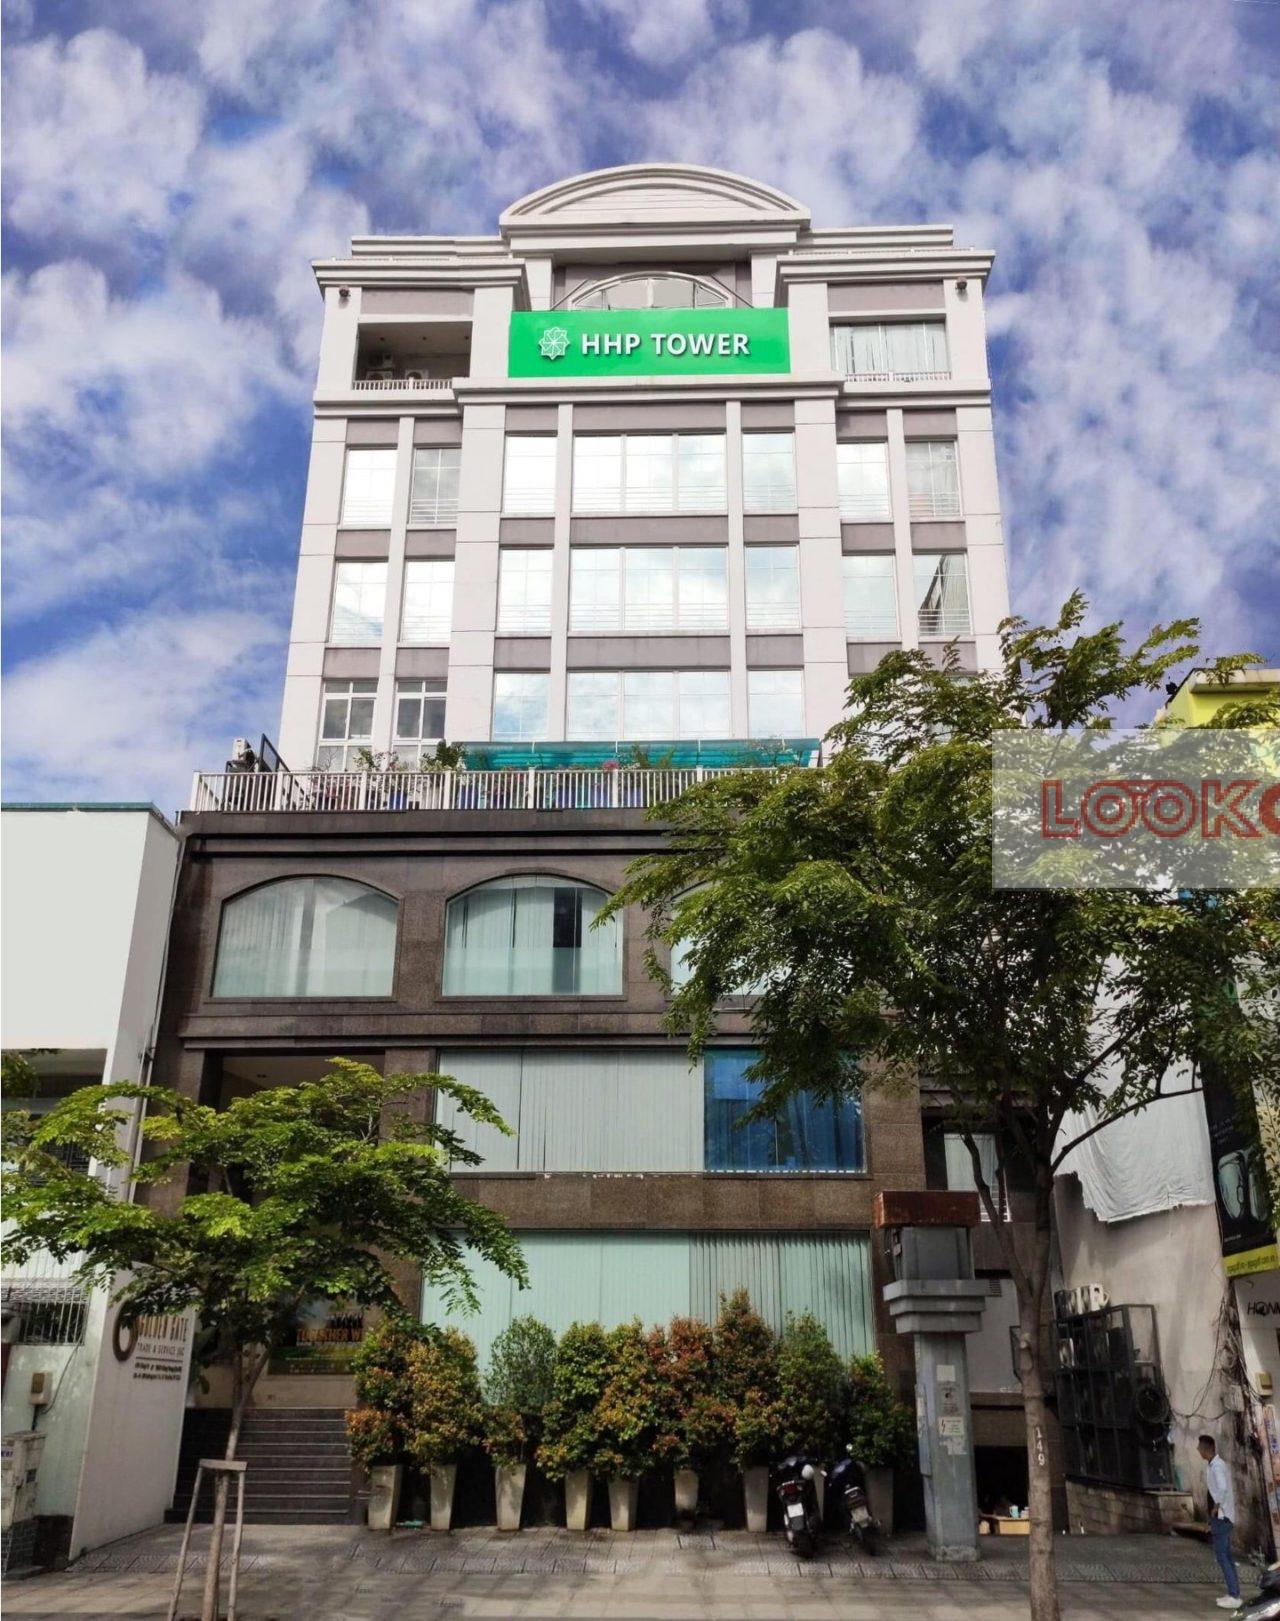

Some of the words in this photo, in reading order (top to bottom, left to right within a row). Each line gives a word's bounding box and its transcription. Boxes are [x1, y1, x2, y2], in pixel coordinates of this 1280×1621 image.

[581, 333, 641, 355] HHP
[650, 332, 750, 355] TOWER
[1035, 1426, 1045, 1466] 149
